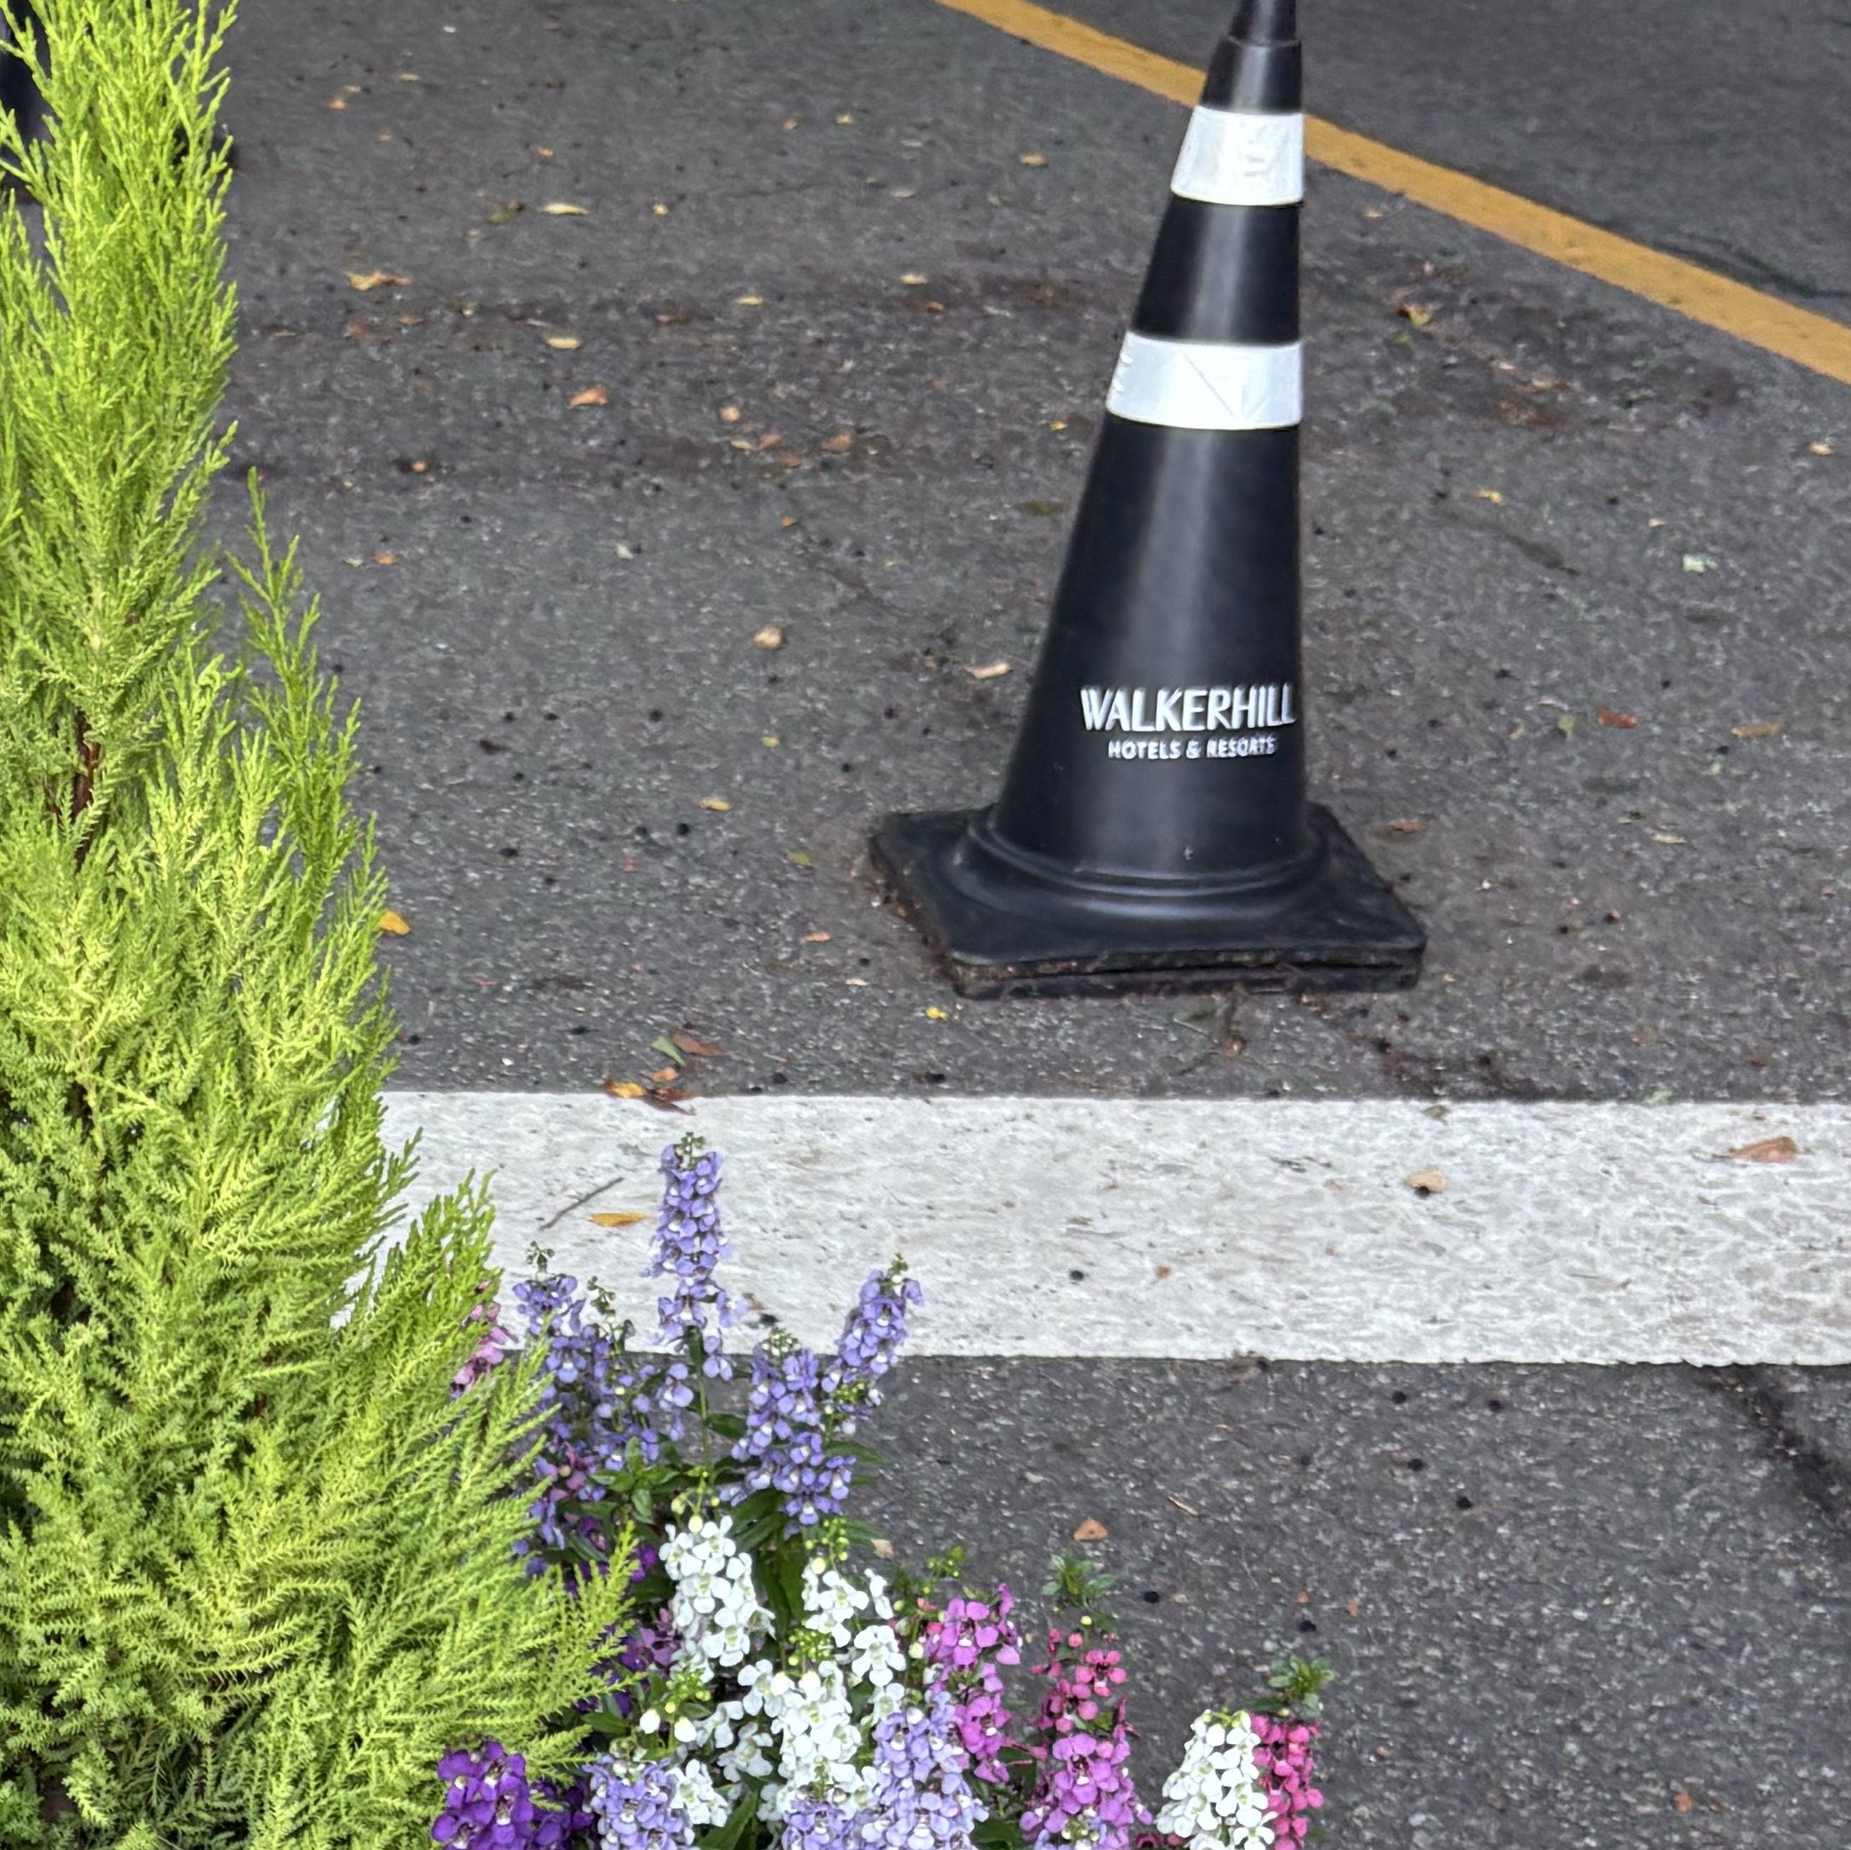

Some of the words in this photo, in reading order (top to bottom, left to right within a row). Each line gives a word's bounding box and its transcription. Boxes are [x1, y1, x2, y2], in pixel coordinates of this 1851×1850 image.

[1080, 683, 1296, 731] WALKERHILL
[1108, 739, 1181, 759] HOTELS
[1186, 739, 1201, 758] &
[1207, 735, 1276, 757] RESORTS
